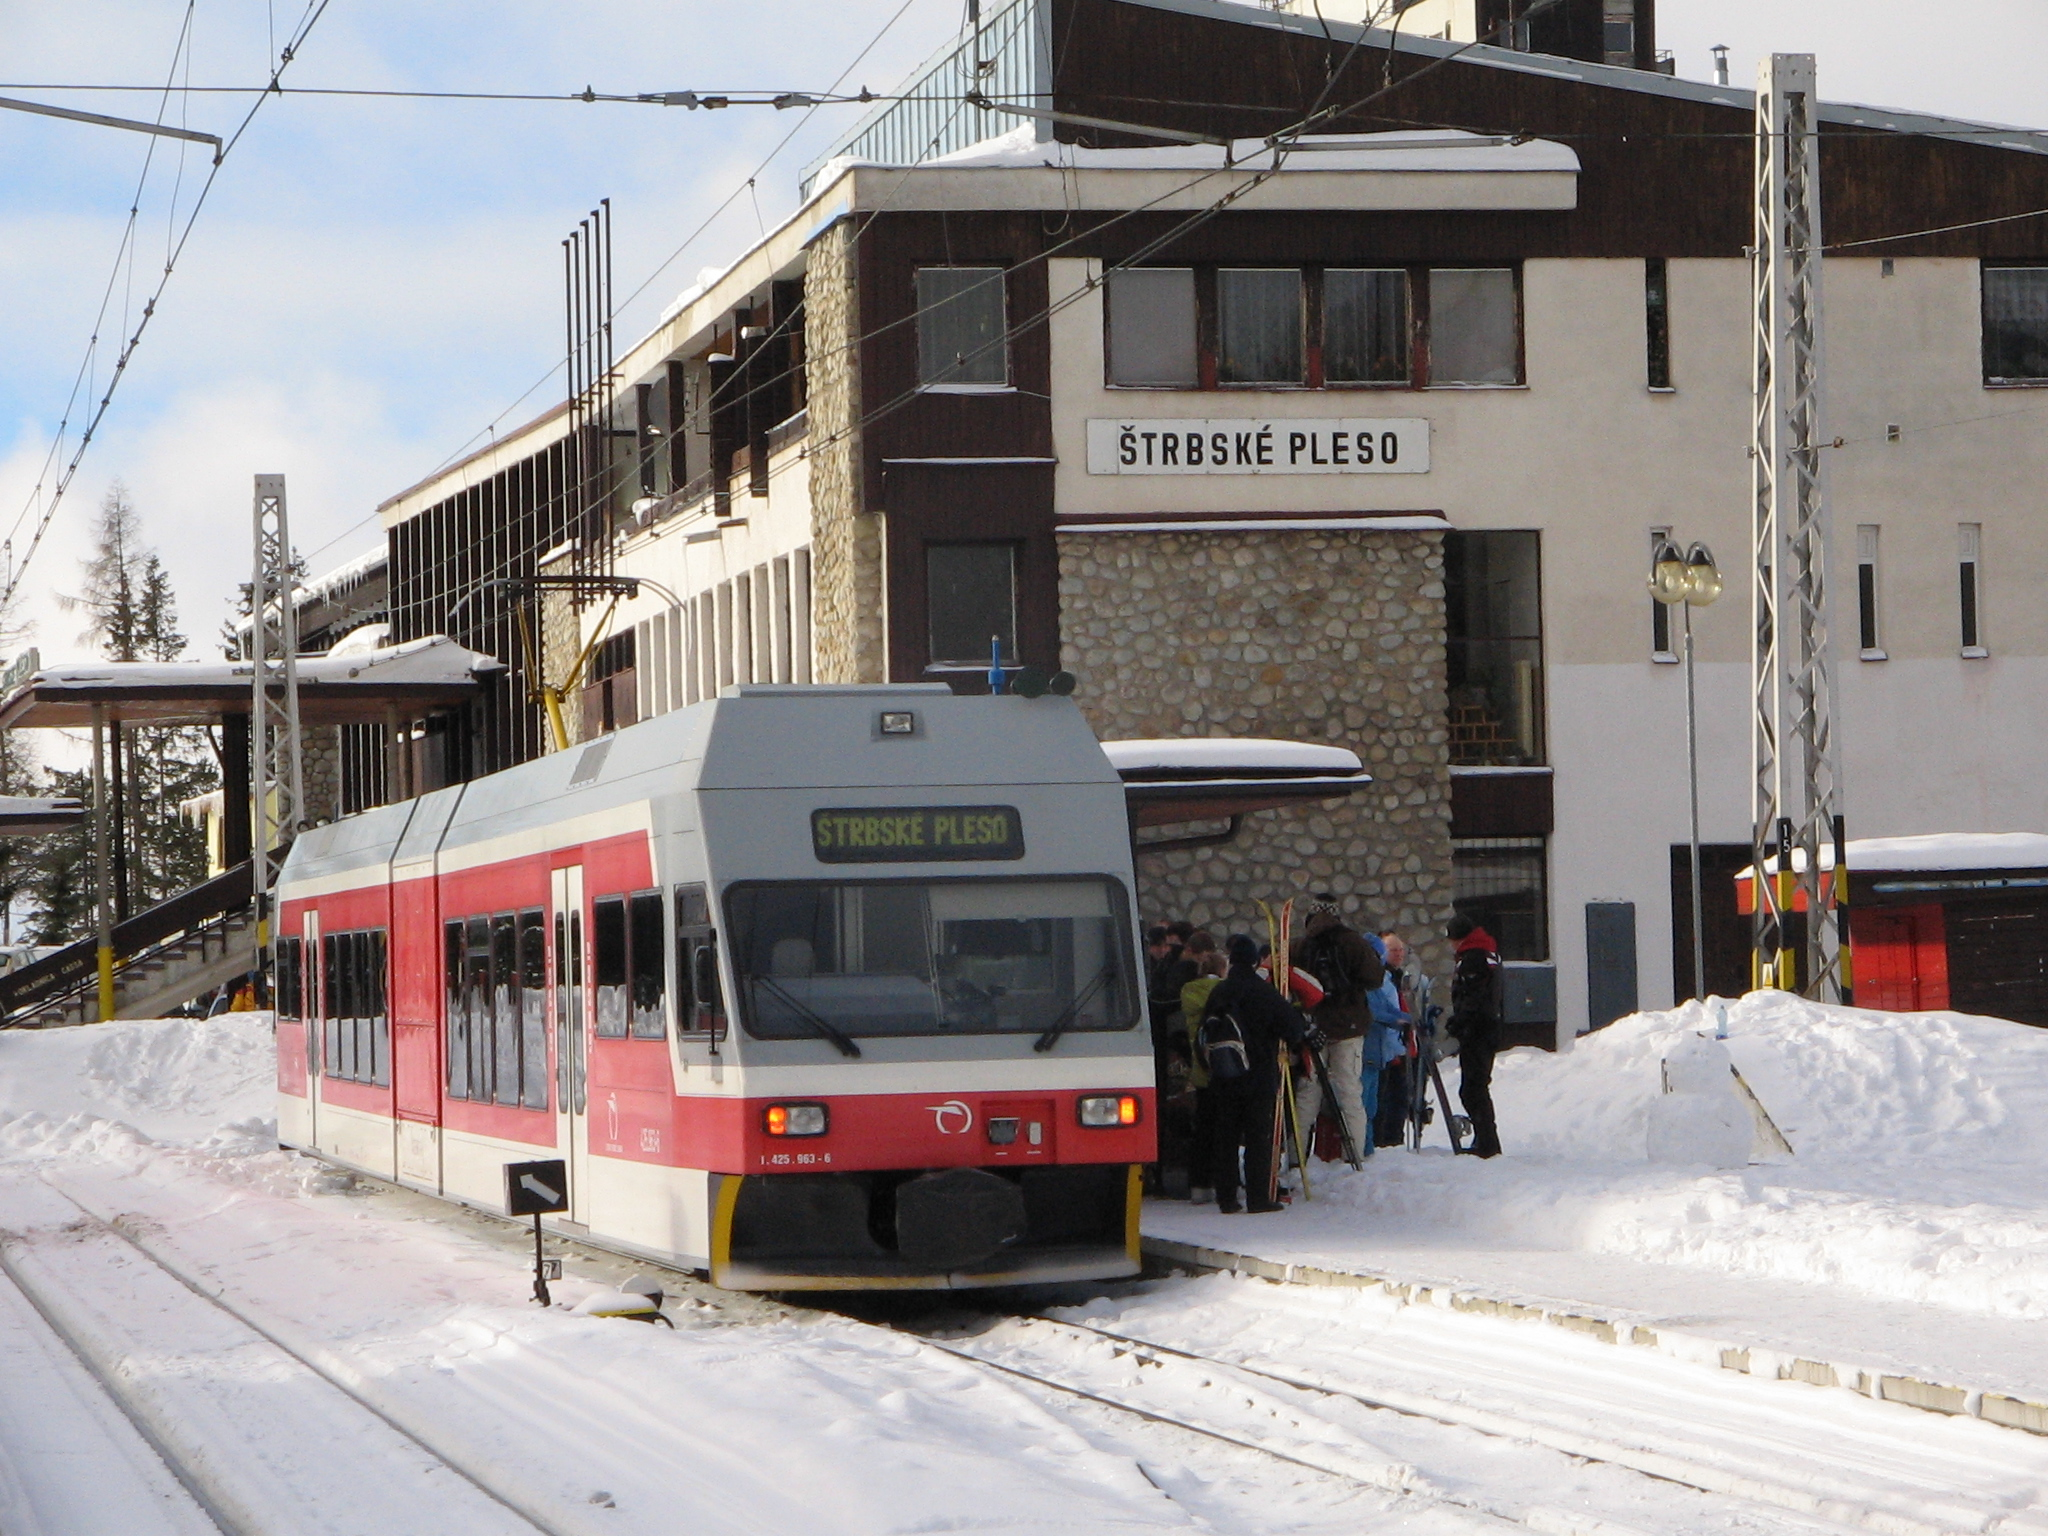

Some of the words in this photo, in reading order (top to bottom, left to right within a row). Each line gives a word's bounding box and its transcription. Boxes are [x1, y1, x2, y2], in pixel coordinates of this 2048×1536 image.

[1119, 425, 1273, 466] ŠTRBSKÉ
[1289, 431, 1398, 465] PLESO
[934, 814, 1008, 845] PLESO
